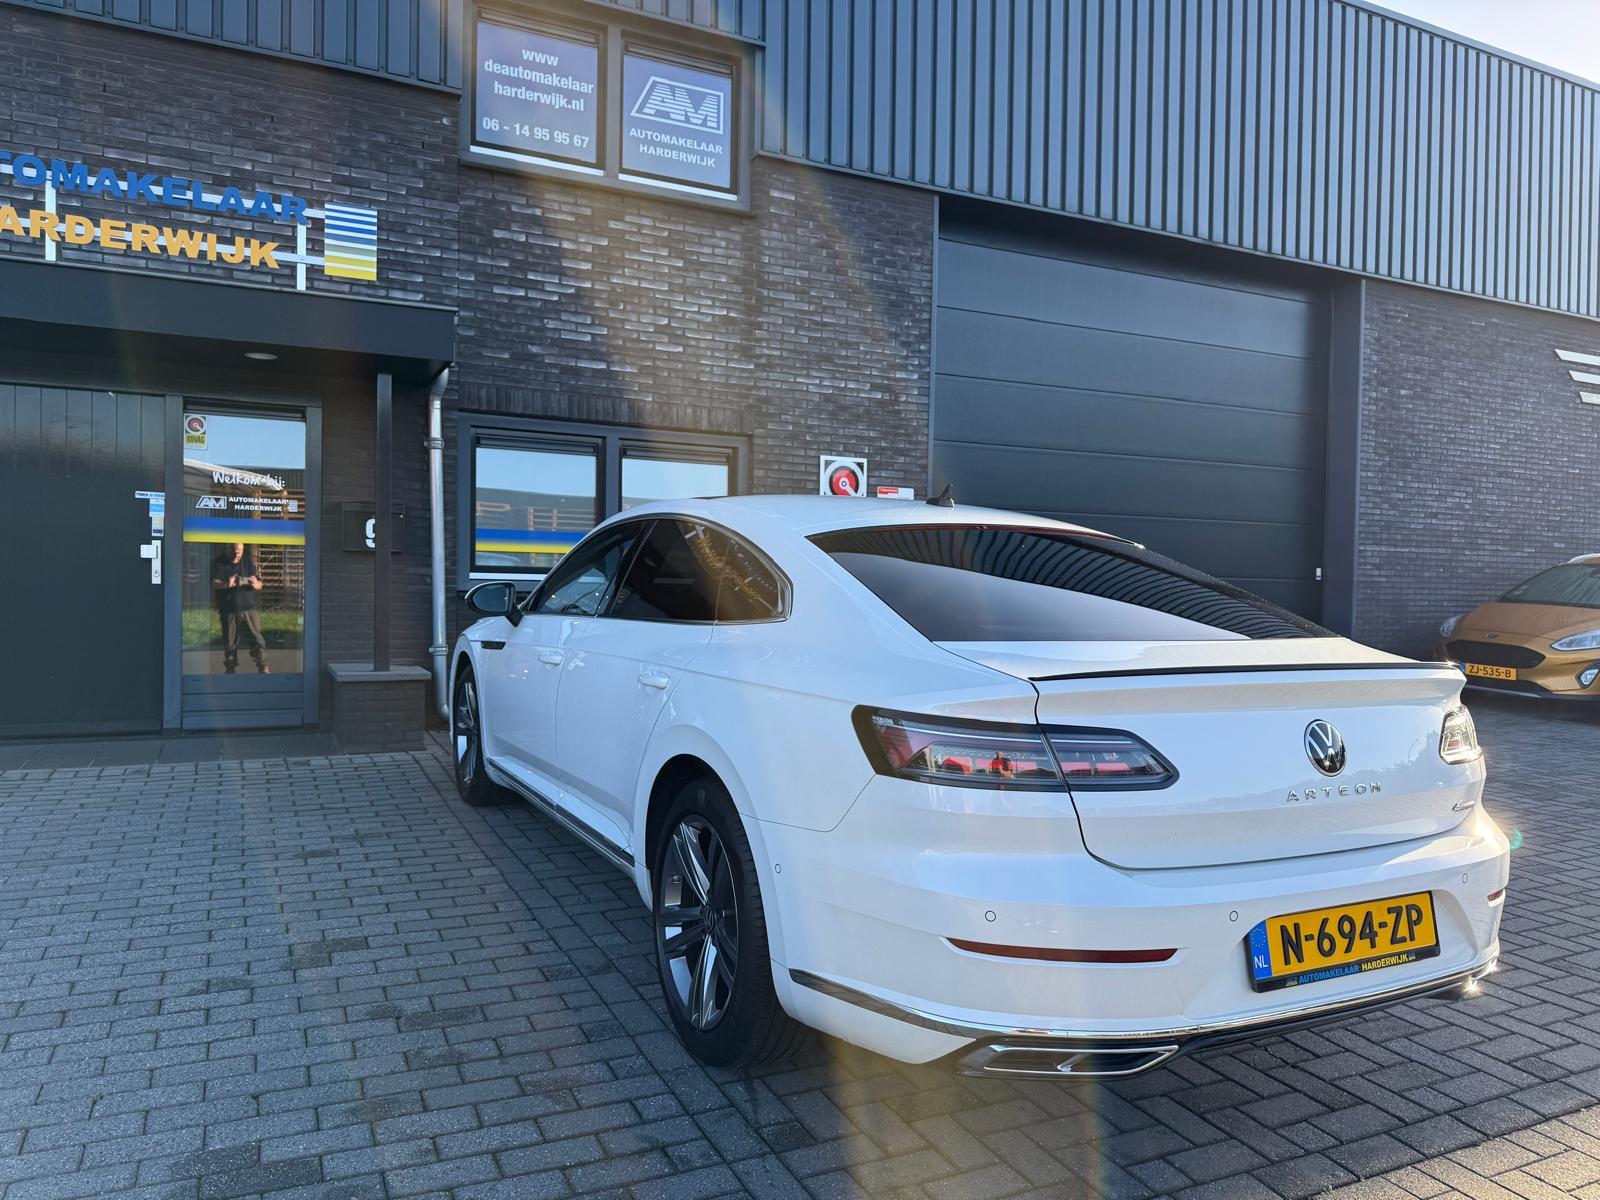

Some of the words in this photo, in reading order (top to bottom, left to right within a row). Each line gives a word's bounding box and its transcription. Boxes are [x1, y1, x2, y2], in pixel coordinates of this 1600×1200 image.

[521, 49, 559, 67] www
[484, 59, 595, 95] deautomakelaar
[493, 81, 585, 112] harderwijk.nl
[482, 117, 500, 132] 06
[513, 122, 531, 138] 14
[533, 126, 550, 142] 95
[553, 130, 570, 145] 95
[573, 134, 590, 149] 67
[629, 127, 723, 155] AUTOMAKELAAR
[639, 143, 716, 169] HARDERWIJK
[212, 471, 260, 486] Welkom
[228, 496, 288, 505] AUTOMAKELAAR
[234, 504, 282, 512] HARDERWIJK
[1469, 664, 1511, 678] ZJ-535-B
[1286, 781, 1381, 803] ARTEON
[1280, 903, 1424, 967] N-694-ZP
[1254, 955, 1269, 969] NL
[1298, 965, 1360, 984] AUTOMAKELAAR
[1361, 953, 1409, 971] HARDERWIJK
